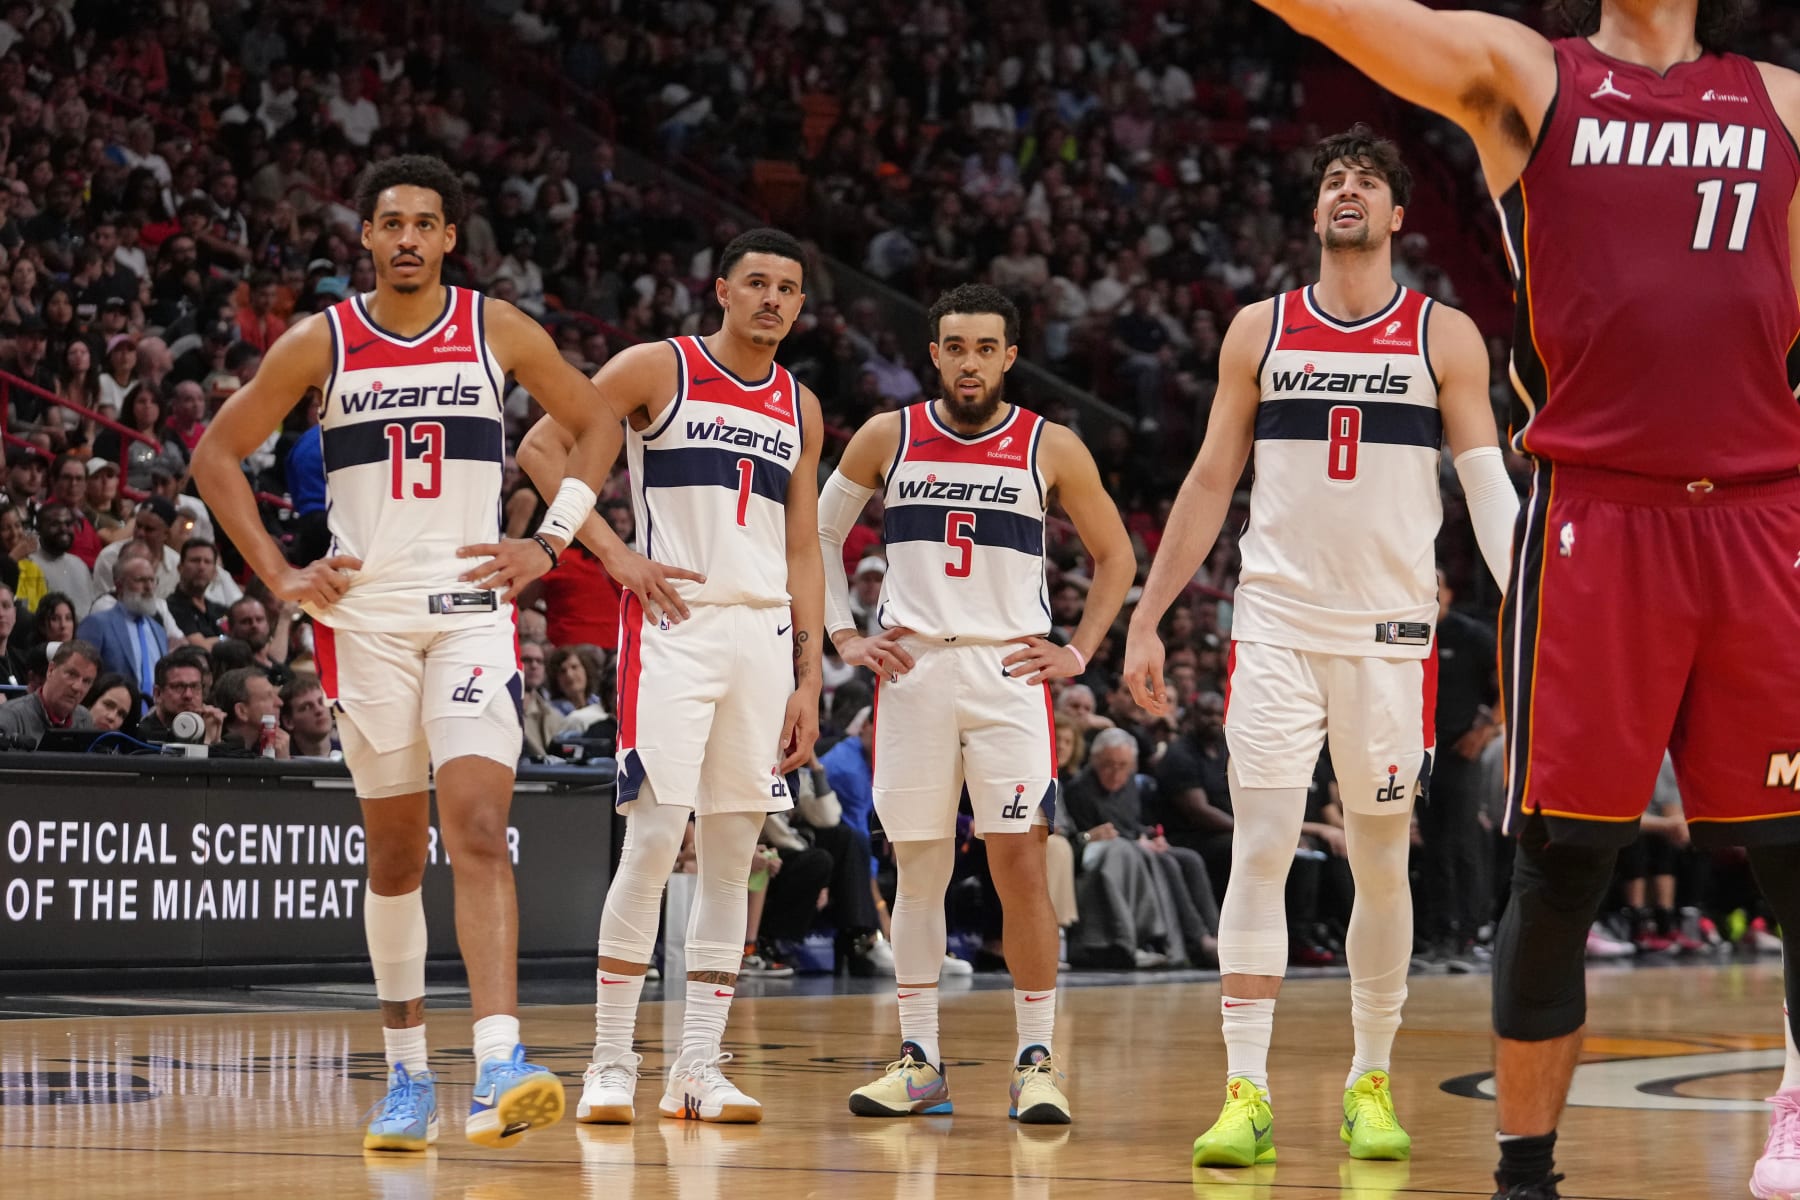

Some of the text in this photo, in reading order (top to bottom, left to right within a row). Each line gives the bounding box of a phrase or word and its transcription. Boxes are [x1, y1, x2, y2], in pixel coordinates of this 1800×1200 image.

[1570, 117, 1767, 171] MIAMI
[1691, 179, 1758, 251] 11
[433, 345, 472, 353] Robinhood
[1373, 338, 1412, 347] Robinhood
[341, 373, 483, 415] wizards
[1272, 363, 1412, 395] wizards
[384, 421, 445, 500] 13
[686, 416, 794, 461] wizards
[986, 451, 1022, 461] Robinhood
[1328, 405, 1362, 482] 8
[736, 458, 755, 527] 1
[899, 473, 1022, 504] wizards
[944, 511, 977, 579] 5
[8, 820, 366, 865] OFFICIAL SCENTING
[6, 878, 359, 921] OF THE MIAMI HEAT
